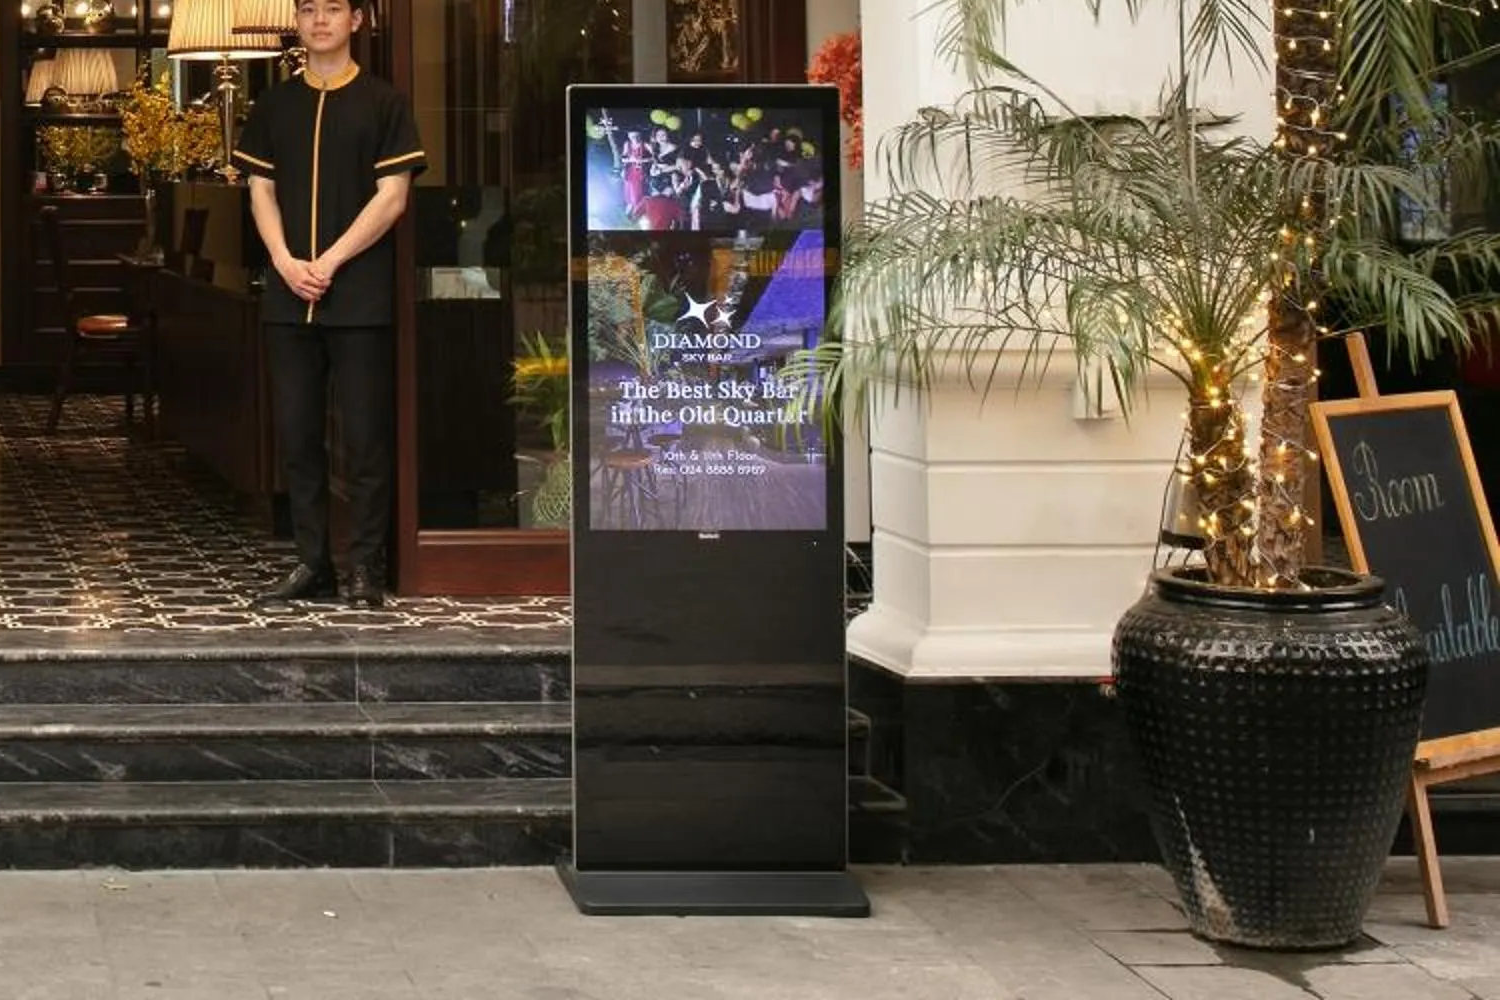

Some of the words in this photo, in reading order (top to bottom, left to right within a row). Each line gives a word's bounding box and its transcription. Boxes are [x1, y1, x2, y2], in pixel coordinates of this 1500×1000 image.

[653, 333, 761, 350] DIAMOND
[681, 353, 705, 362] SKY
[707, 353, 733, 362] BAR
[619, 381, 660, 399] The
[666, 381, 713, 399] Best
[718, 380, 756, 403] Sky
[762, 380, 799, 399] Bar
[611, 405, 632, 424] in
[638, 405, 673, 424] the
[679, 405, 716, 425] Old
[723, 405, 808, 427] Quarter
[727, 449, 757, 461] Floor
[1354, 440, 1445, 521] Room
[1396, 572, 1500, 664] ailable
